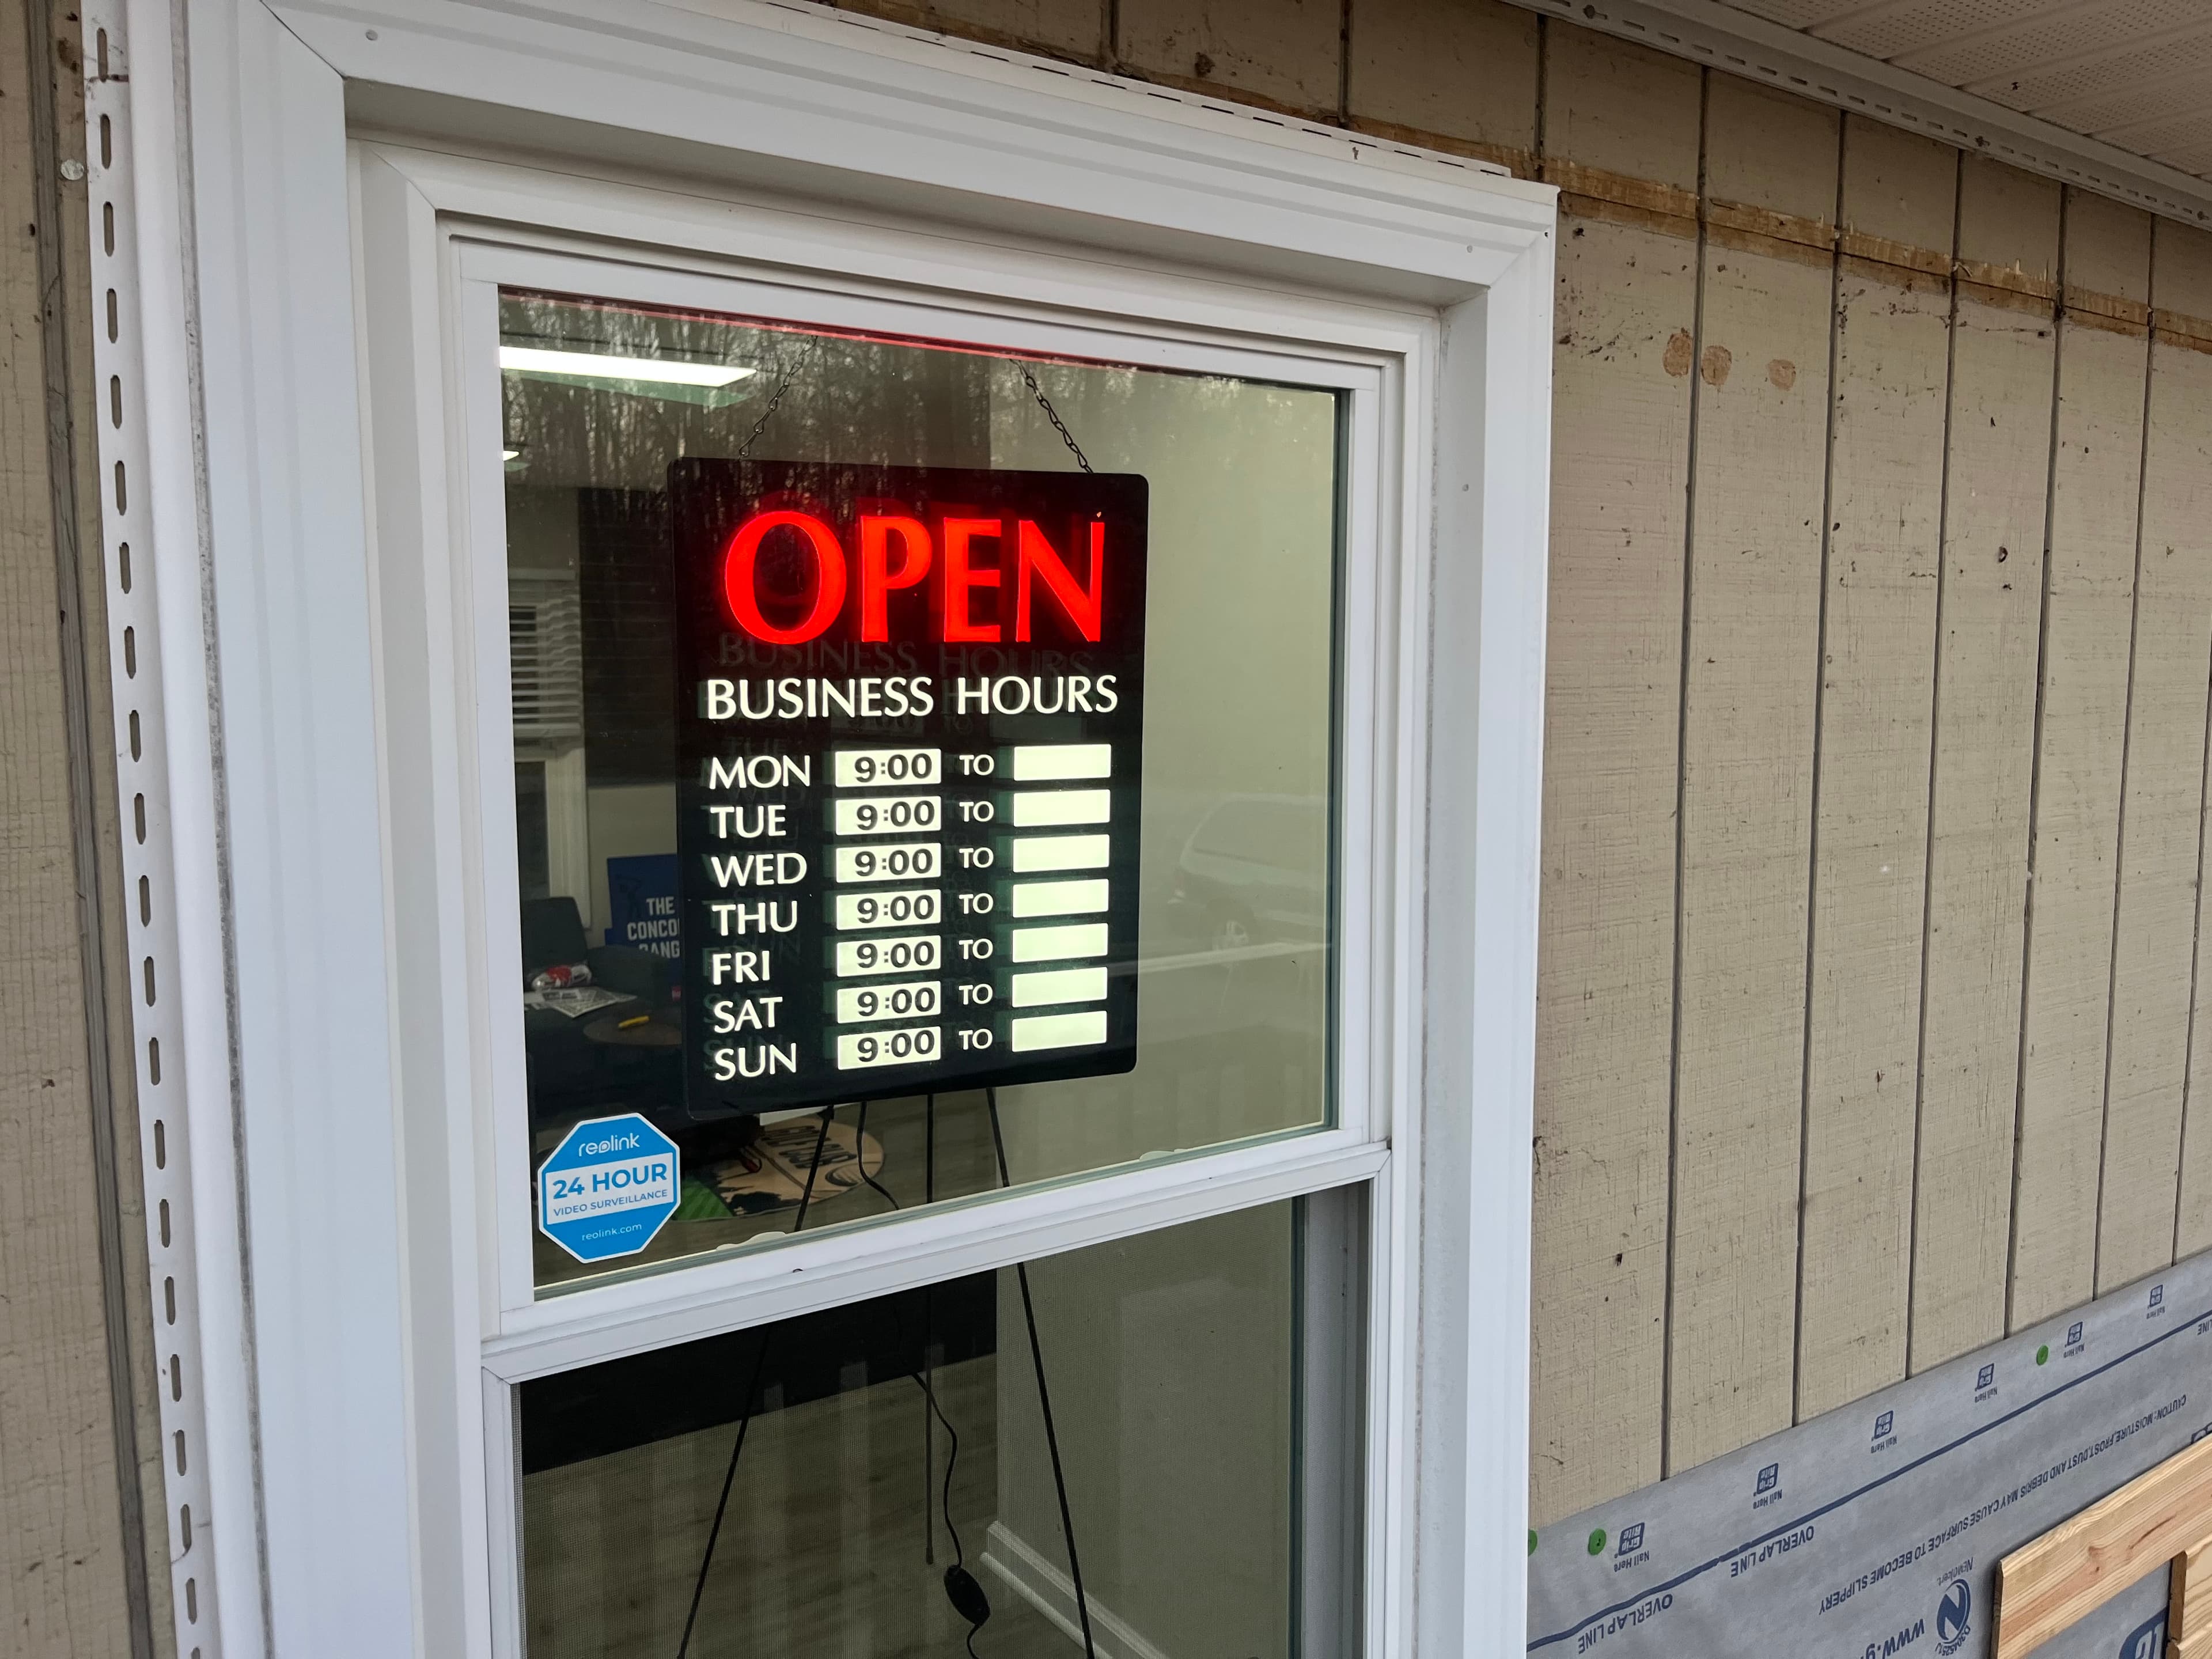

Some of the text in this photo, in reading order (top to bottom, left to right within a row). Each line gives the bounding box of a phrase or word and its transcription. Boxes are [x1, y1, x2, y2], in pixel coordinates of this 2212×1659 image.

[724, 510, 1105, 646] OPEN
[707, 675, 1118, 719] BUSINESS HOURS
[710, 753, 994, 789] MON 9:00 TO
[710, 800, 994, 838] TUE 9:00 TO
[711, 847, 994, 887] WED 9:00 TO
[646, 896, 676, 916] THE
[712, 893, 994, 935] THU 9:00 TO
[627, 918, 680, 941] CONCO
[713, 939, 994, 984] FRI 9:00 TO
[714, 984, 994, 1033] SAT 9:00 TO
[715, 1029, 994, 1080] SUN 9:00 TO
[578, 1132, 640, 1157] reolink
[552, 1162, 668, 1199] 24 HOUR
[553, 1189, 668, 1217] VIDEO SURVEILLANCE
[581, 1223, 642, 1241] reolink.com
[2020, 1470, 2049, 1498] DEBRIS
[2050, 1461, 2067, 1479] AND
[1969, 1499, 1999, 1527] CAUSE
[1999, 1488, 2019, 1510] MAY
[1914, 1543, 1926, 1560] TO
[1927, 1516, 1969, 1551] SURFACE
[1613, 1551, 1650, 1573] Nail Here
[1730, 1526, 1814, 1578] OVERLAP LINE
[1868, 1551, 1912, 1585] BECOME
[1818, 1574, 1868, 1616] SLIPPERY
[1577, 1594, 1673, 1654] OVERLAP LINE
[1861, 1619, 1925, 1659] www.g
